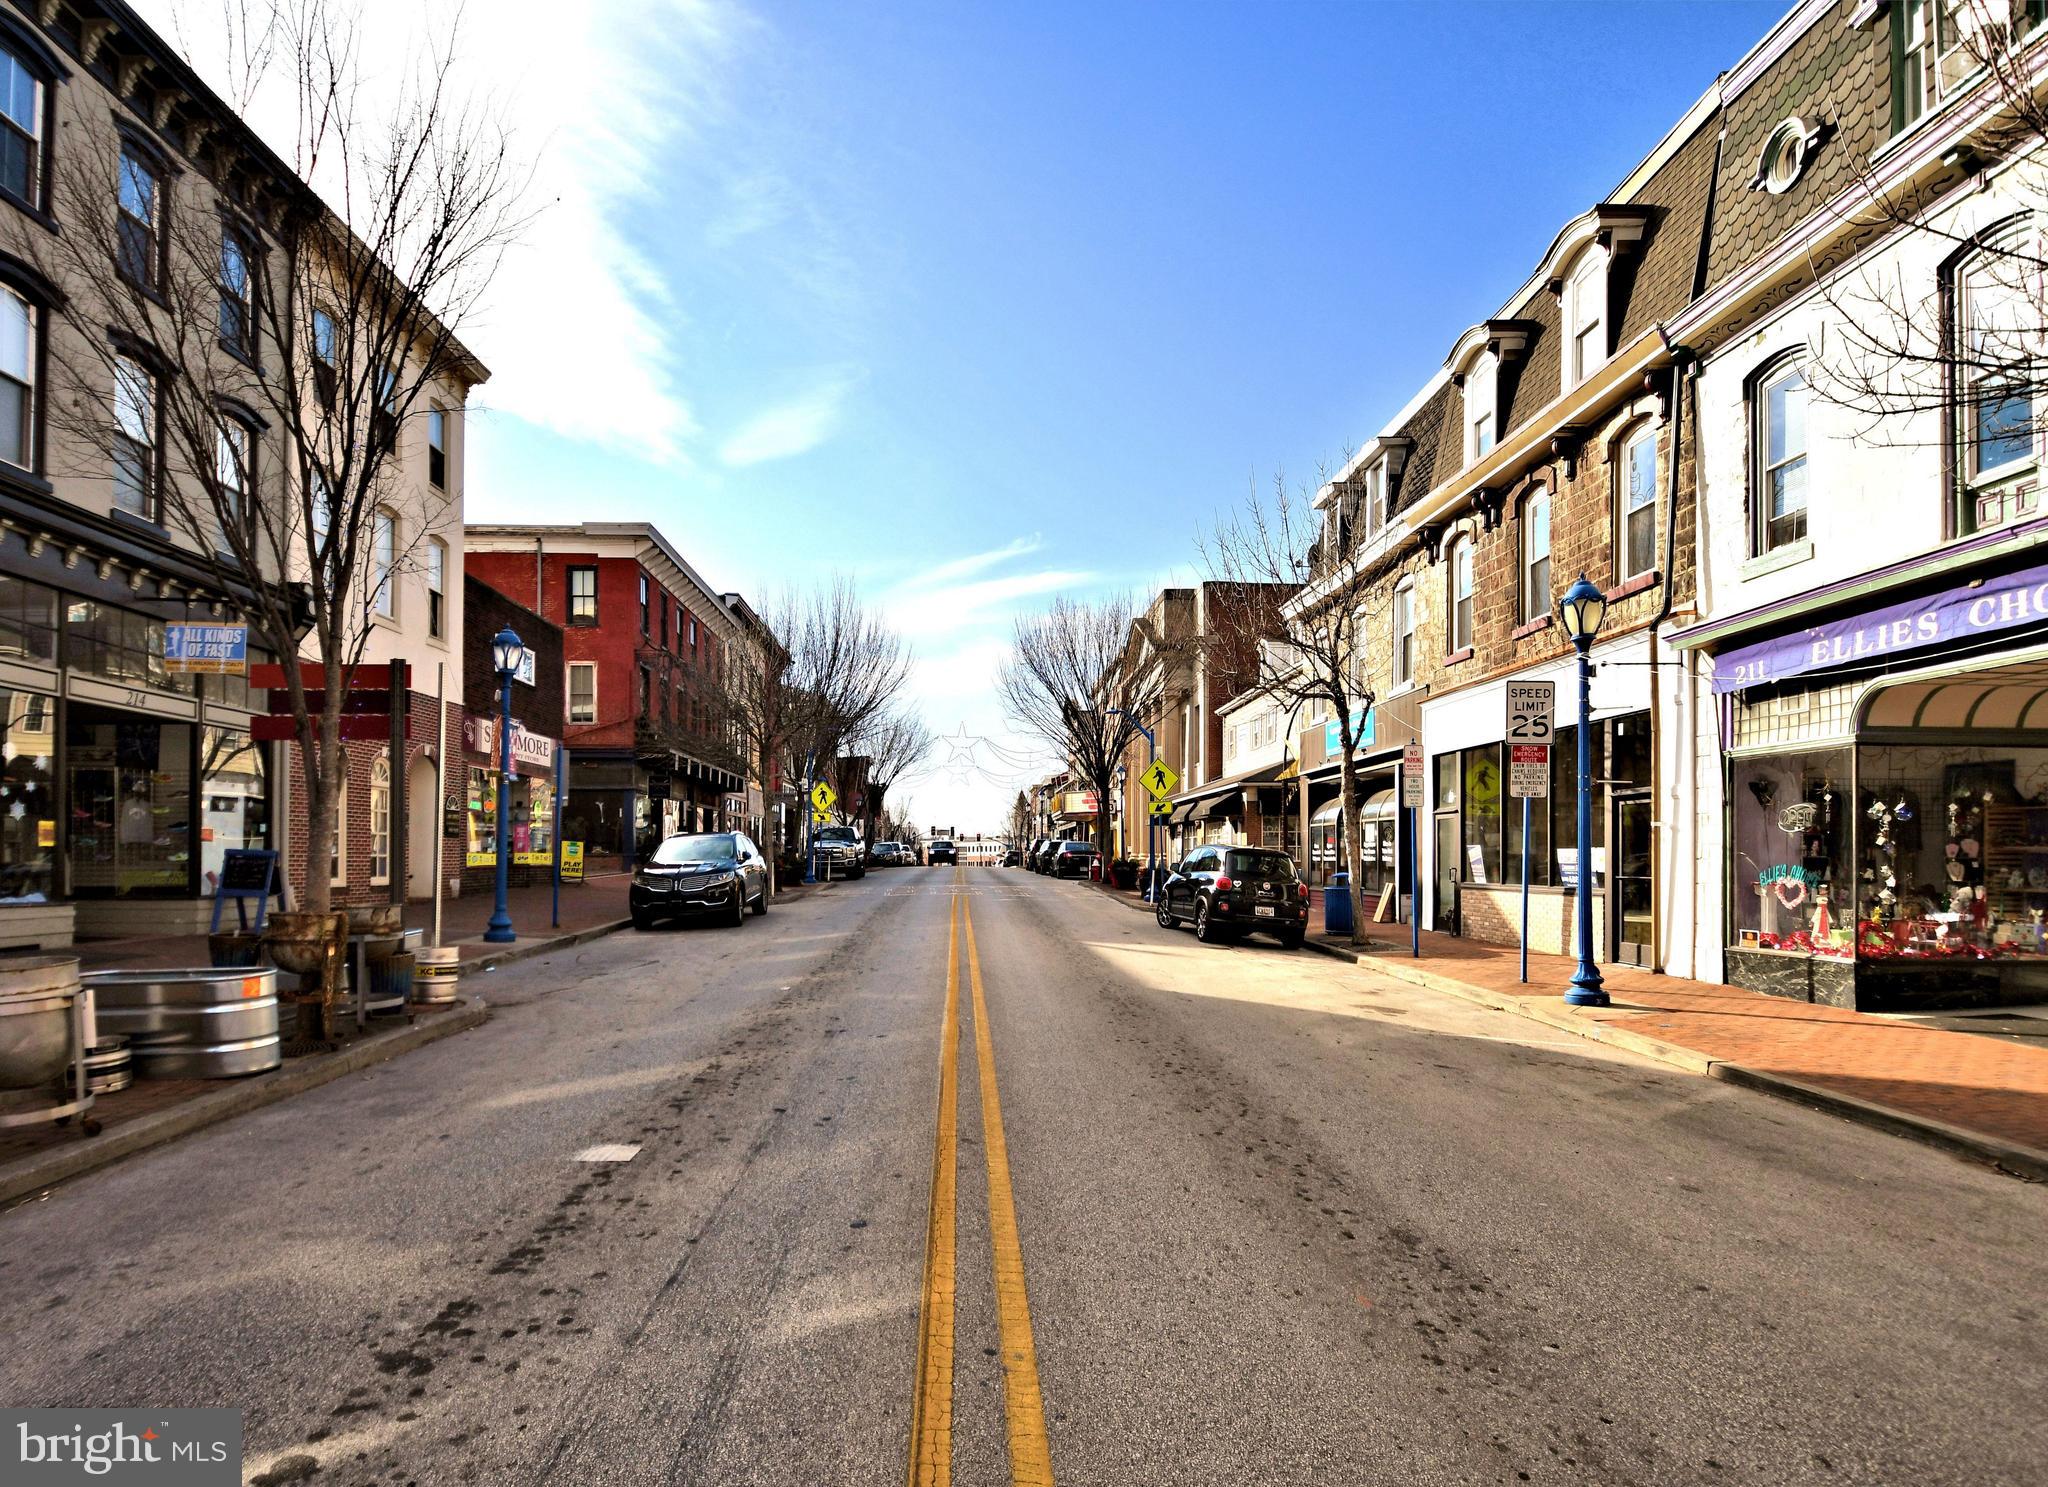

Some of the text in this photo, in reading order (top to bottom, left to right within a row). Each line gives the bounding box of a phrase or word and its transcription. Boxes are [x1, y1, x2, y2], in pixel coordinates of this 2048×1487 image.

[183, 628, 242, 644] ALL KINDS
[1811, 611, 1938, 666] ELLIES
[188, 643, 234, 658] OF FAST
[1735, 659, 1767, 685] 211
[127, 691, 146, 706] 214
[1511, 688, 1551, 698] SPEED
[1515, 702, 1546, 711] LIMIT
[1512, 714, 1549, 737] 25
[1759, 864, 1788, 887] ELLIE'S
